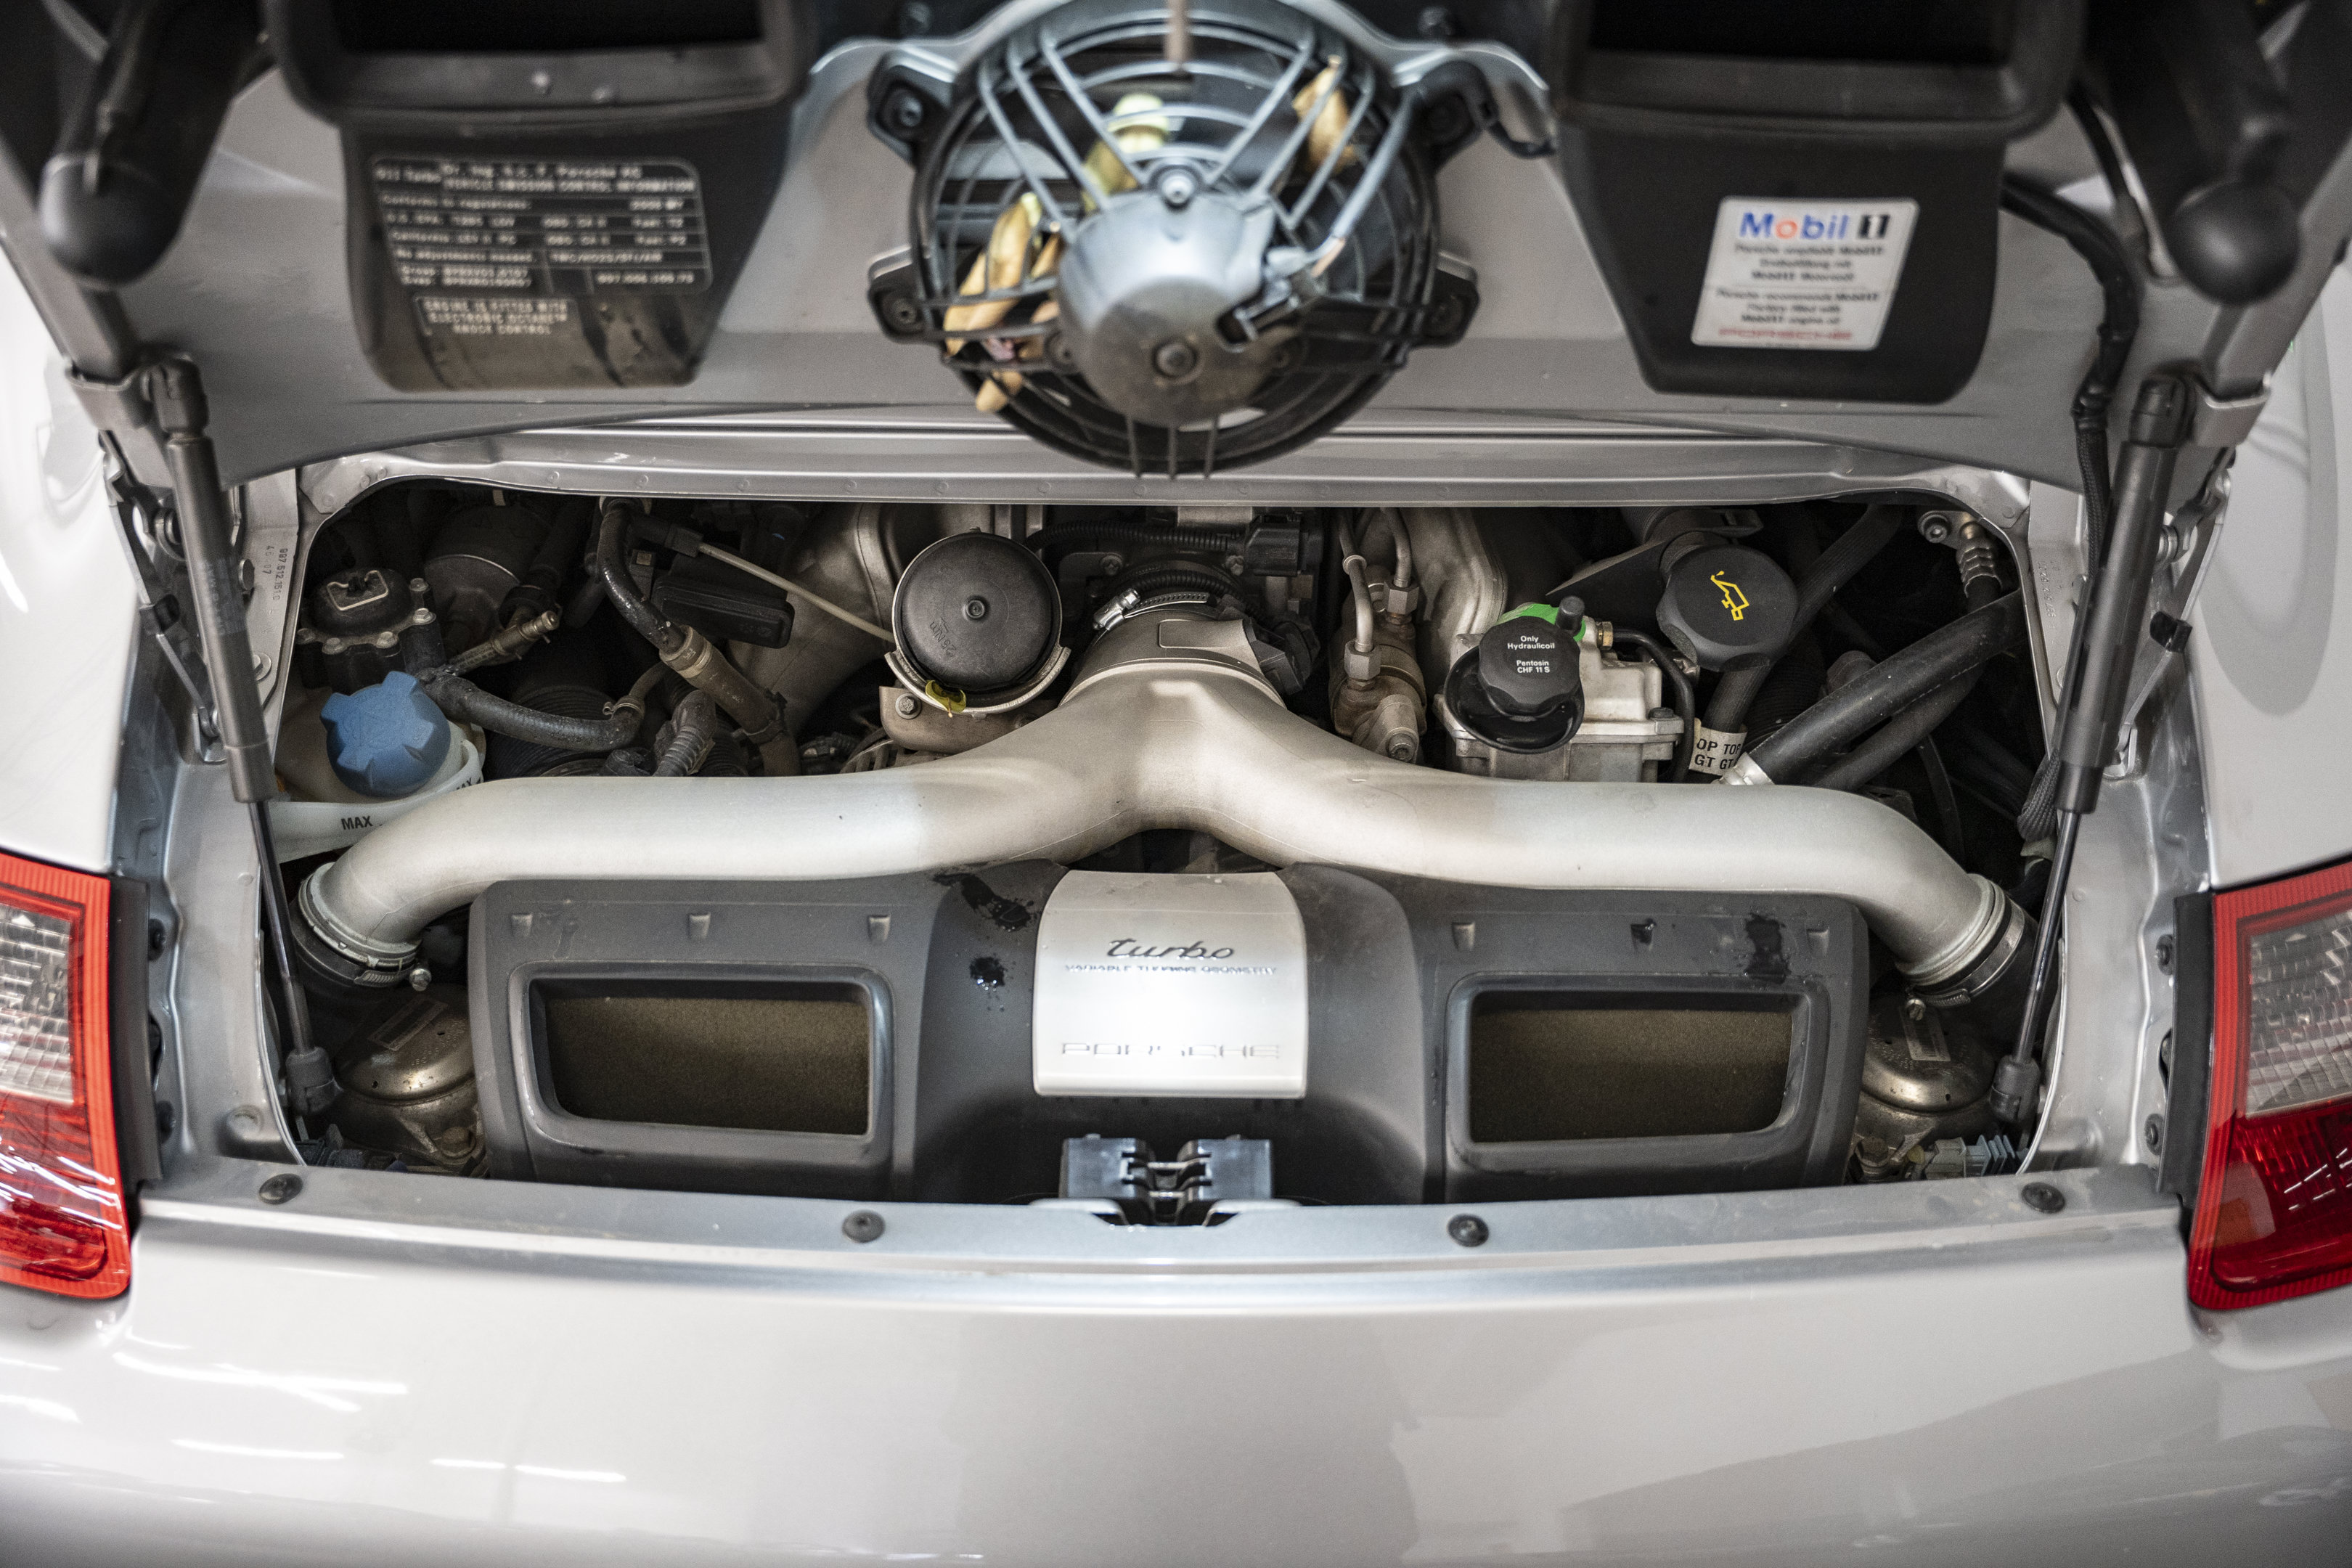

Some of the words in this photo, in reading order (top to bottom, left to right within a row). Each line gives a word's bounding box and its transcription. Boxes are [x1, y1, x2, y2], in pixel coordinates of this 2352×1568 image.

[1739, 212, 1849, 240] Mobil
[1694, 754, 1715, 768] GT
[455, 777, 473, 791] AX
[340, 816, 373, 830] MAX
[1106, 937, 1235, 959] turbo
[1062, 1041, 1280, 1060] PORCHE
